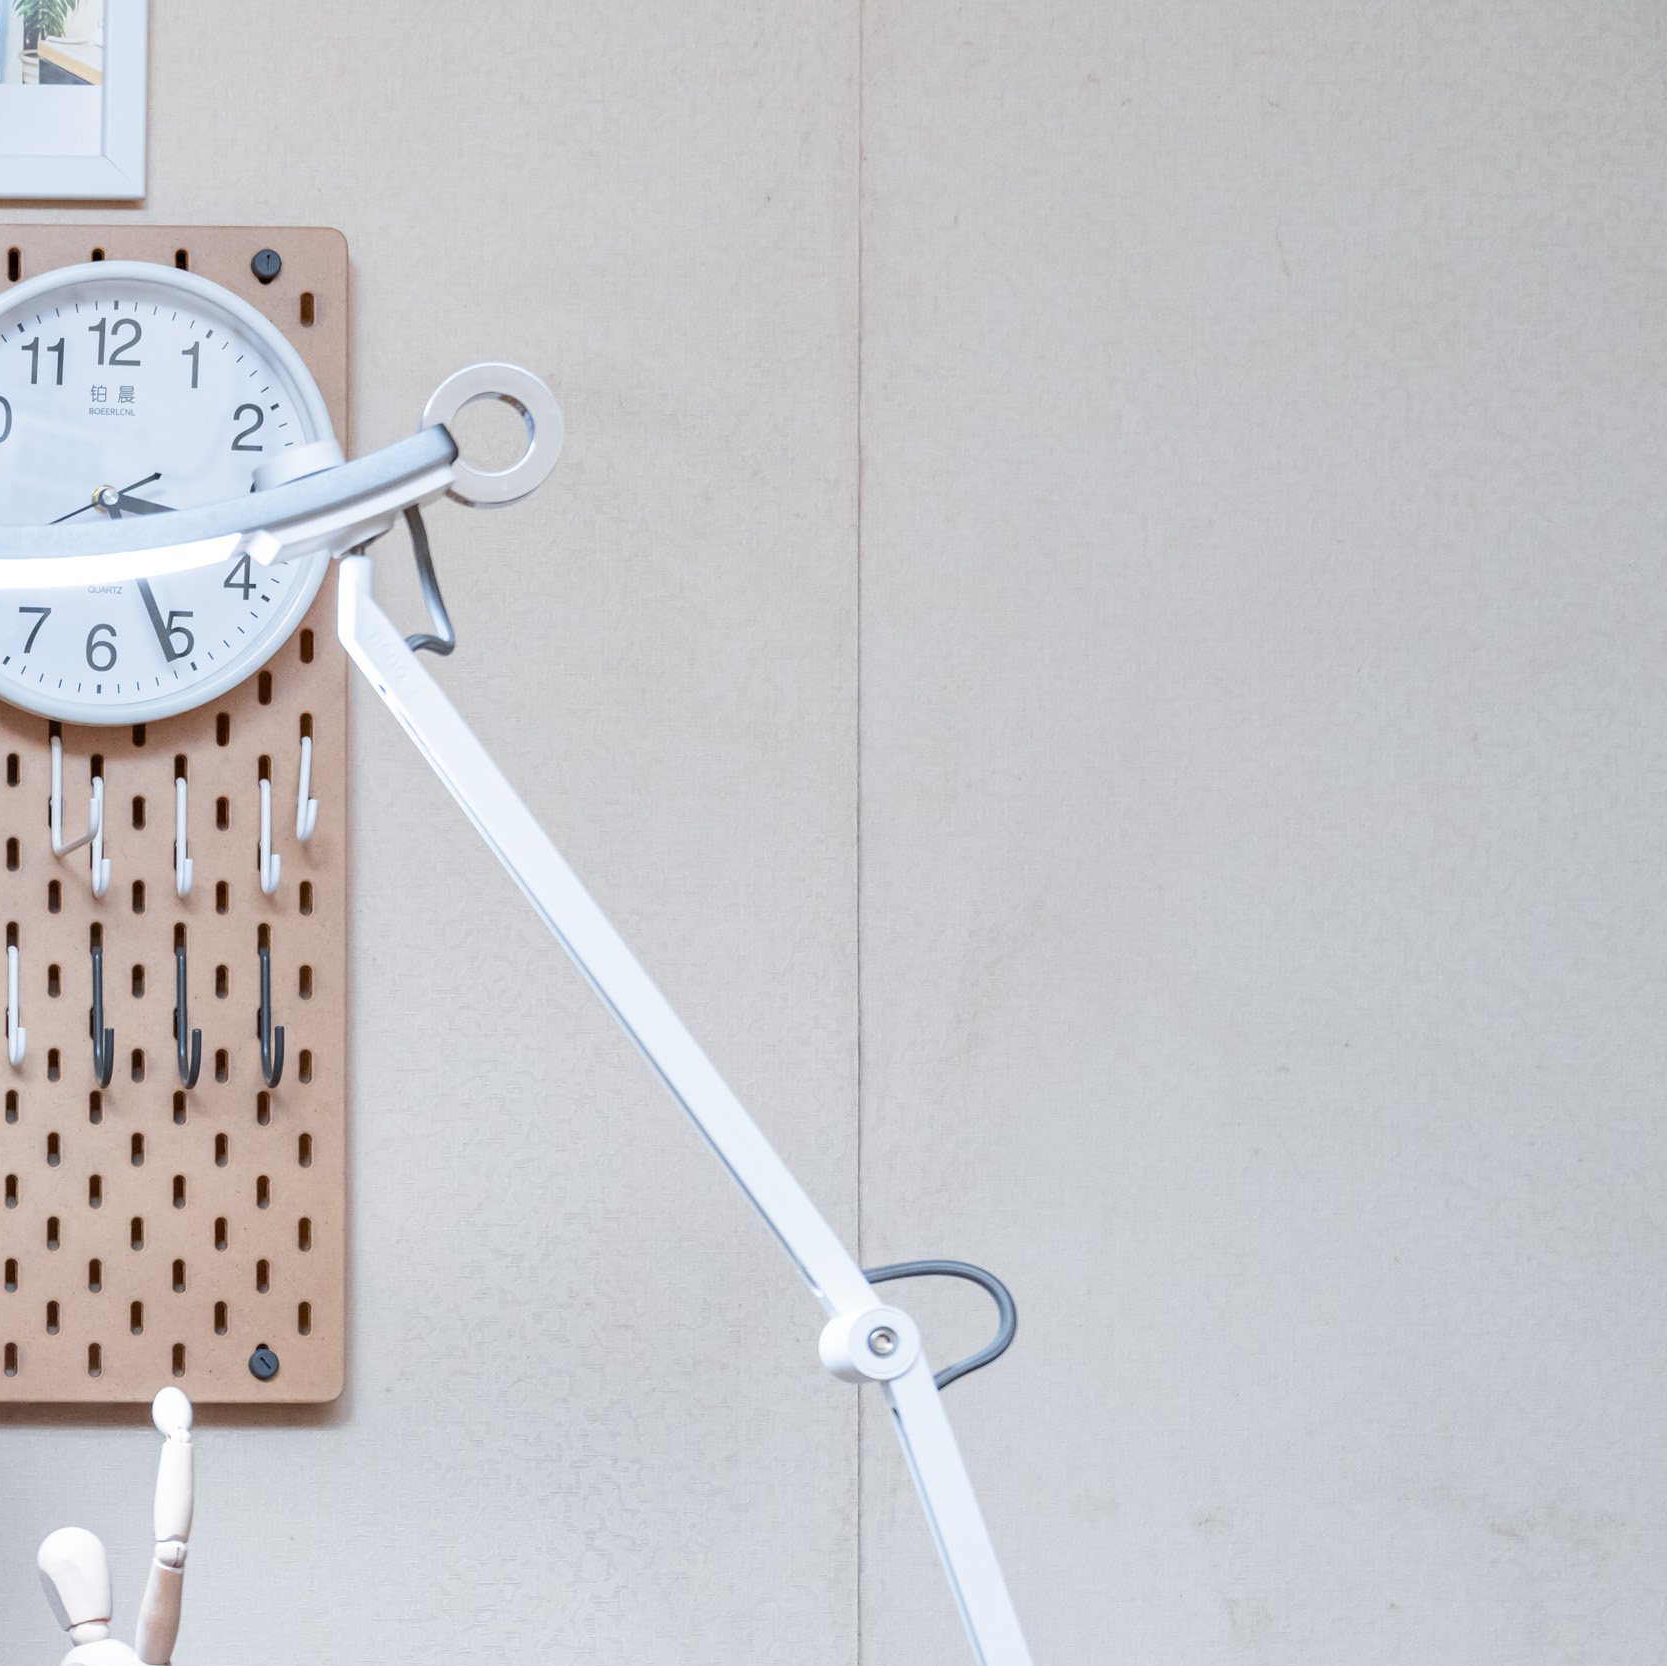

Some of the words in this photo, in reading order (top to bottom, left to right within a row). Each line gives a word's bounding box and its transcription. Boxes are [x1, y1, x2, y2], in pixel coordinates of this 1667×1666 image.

[21, 336, 66, 386] 11
[88, 317, 143, 366] 12
[181, 340, 200, 389] 1
[231, 403, 265, 452] 2
[87, 585, 123, 595] QUARTZ
[223, 554, 257, 600] 4
[18, 606, 52, 654] 7
[85, 623, 118, 671] 6
[167, 610, 195, 661] 5
